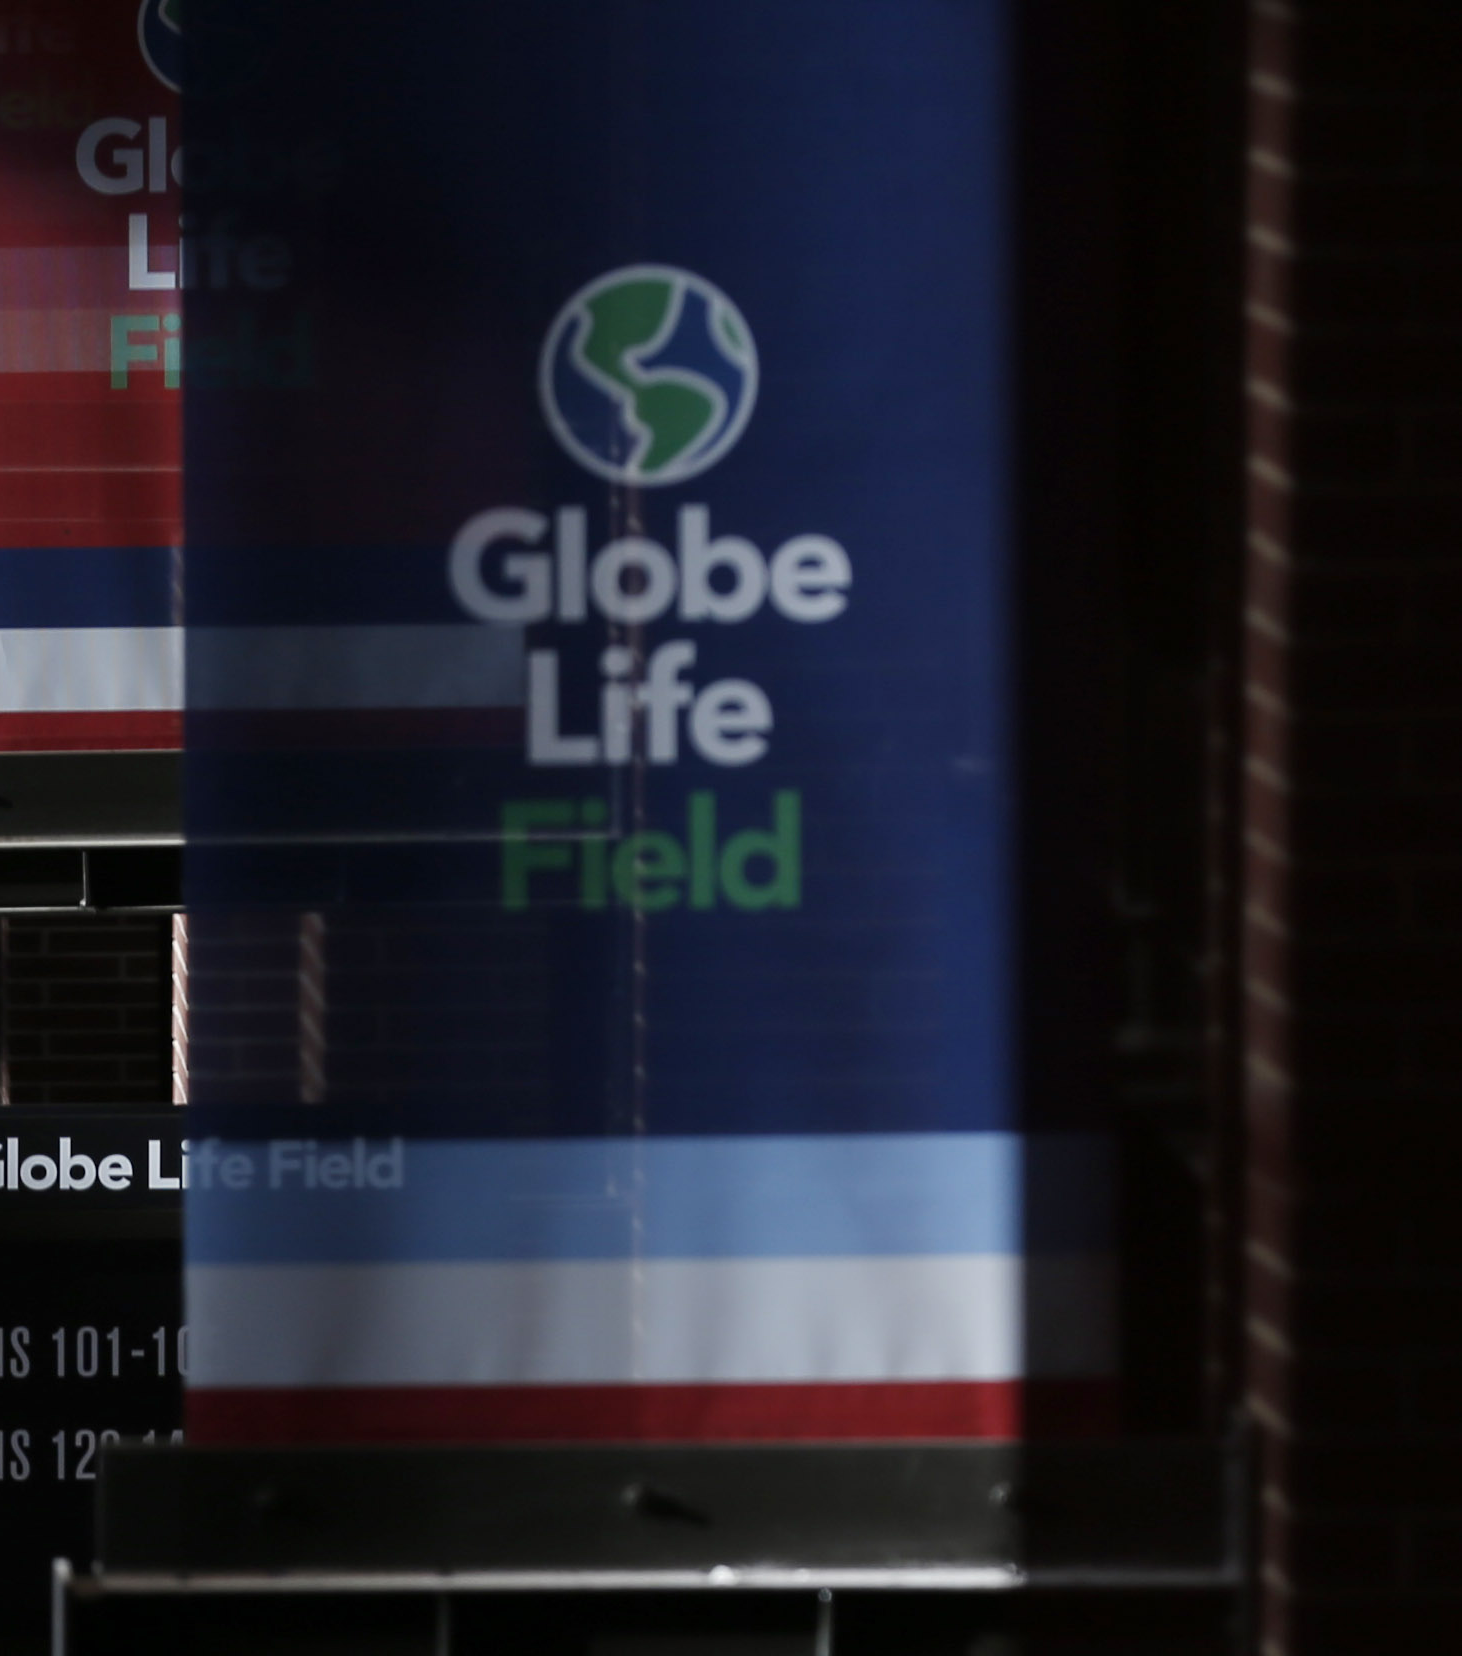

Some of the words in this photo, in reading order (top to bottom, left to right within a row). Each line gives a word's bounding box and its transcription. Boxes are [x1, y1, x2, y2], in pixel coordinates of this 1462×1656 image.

[446, 502, 854, 626] Globe
[525, 637, 776, 768] Life
[499, 787, 804, 914] Field
[147, 1137, 256, 1190] Life
[268, 1136, 405, 1190] Field
